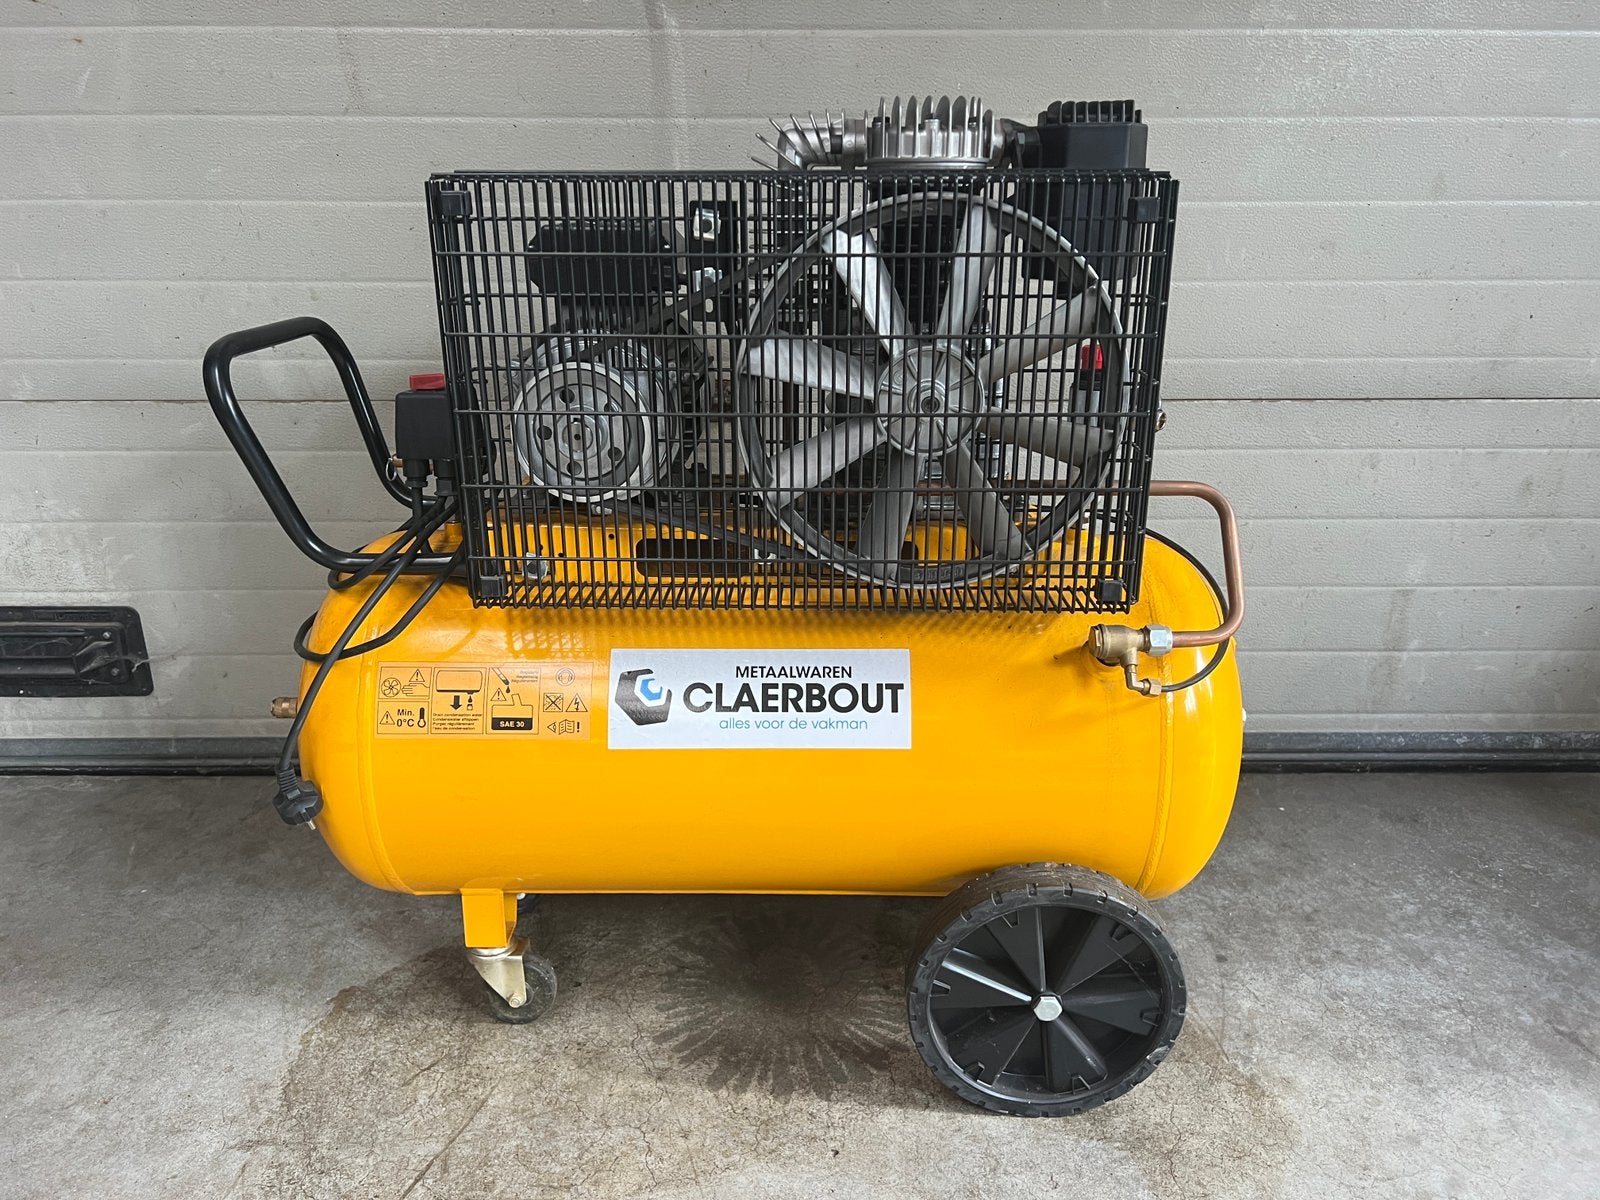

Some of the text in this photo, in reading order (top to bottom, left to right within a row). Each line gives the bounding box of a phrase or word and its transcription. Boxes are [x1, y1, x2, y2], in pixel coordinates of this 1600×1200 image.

[735, 666, 852, 678] METAALWAREN
[683, 682, 905, 714] CLAERBOUT
[397, 708, 415, 717] Min.
[396, 718, 415, 728] 0°C
[499, 720, 525, 728] SAE 30
[719, 717, 868, 730] alles voor de vakman
